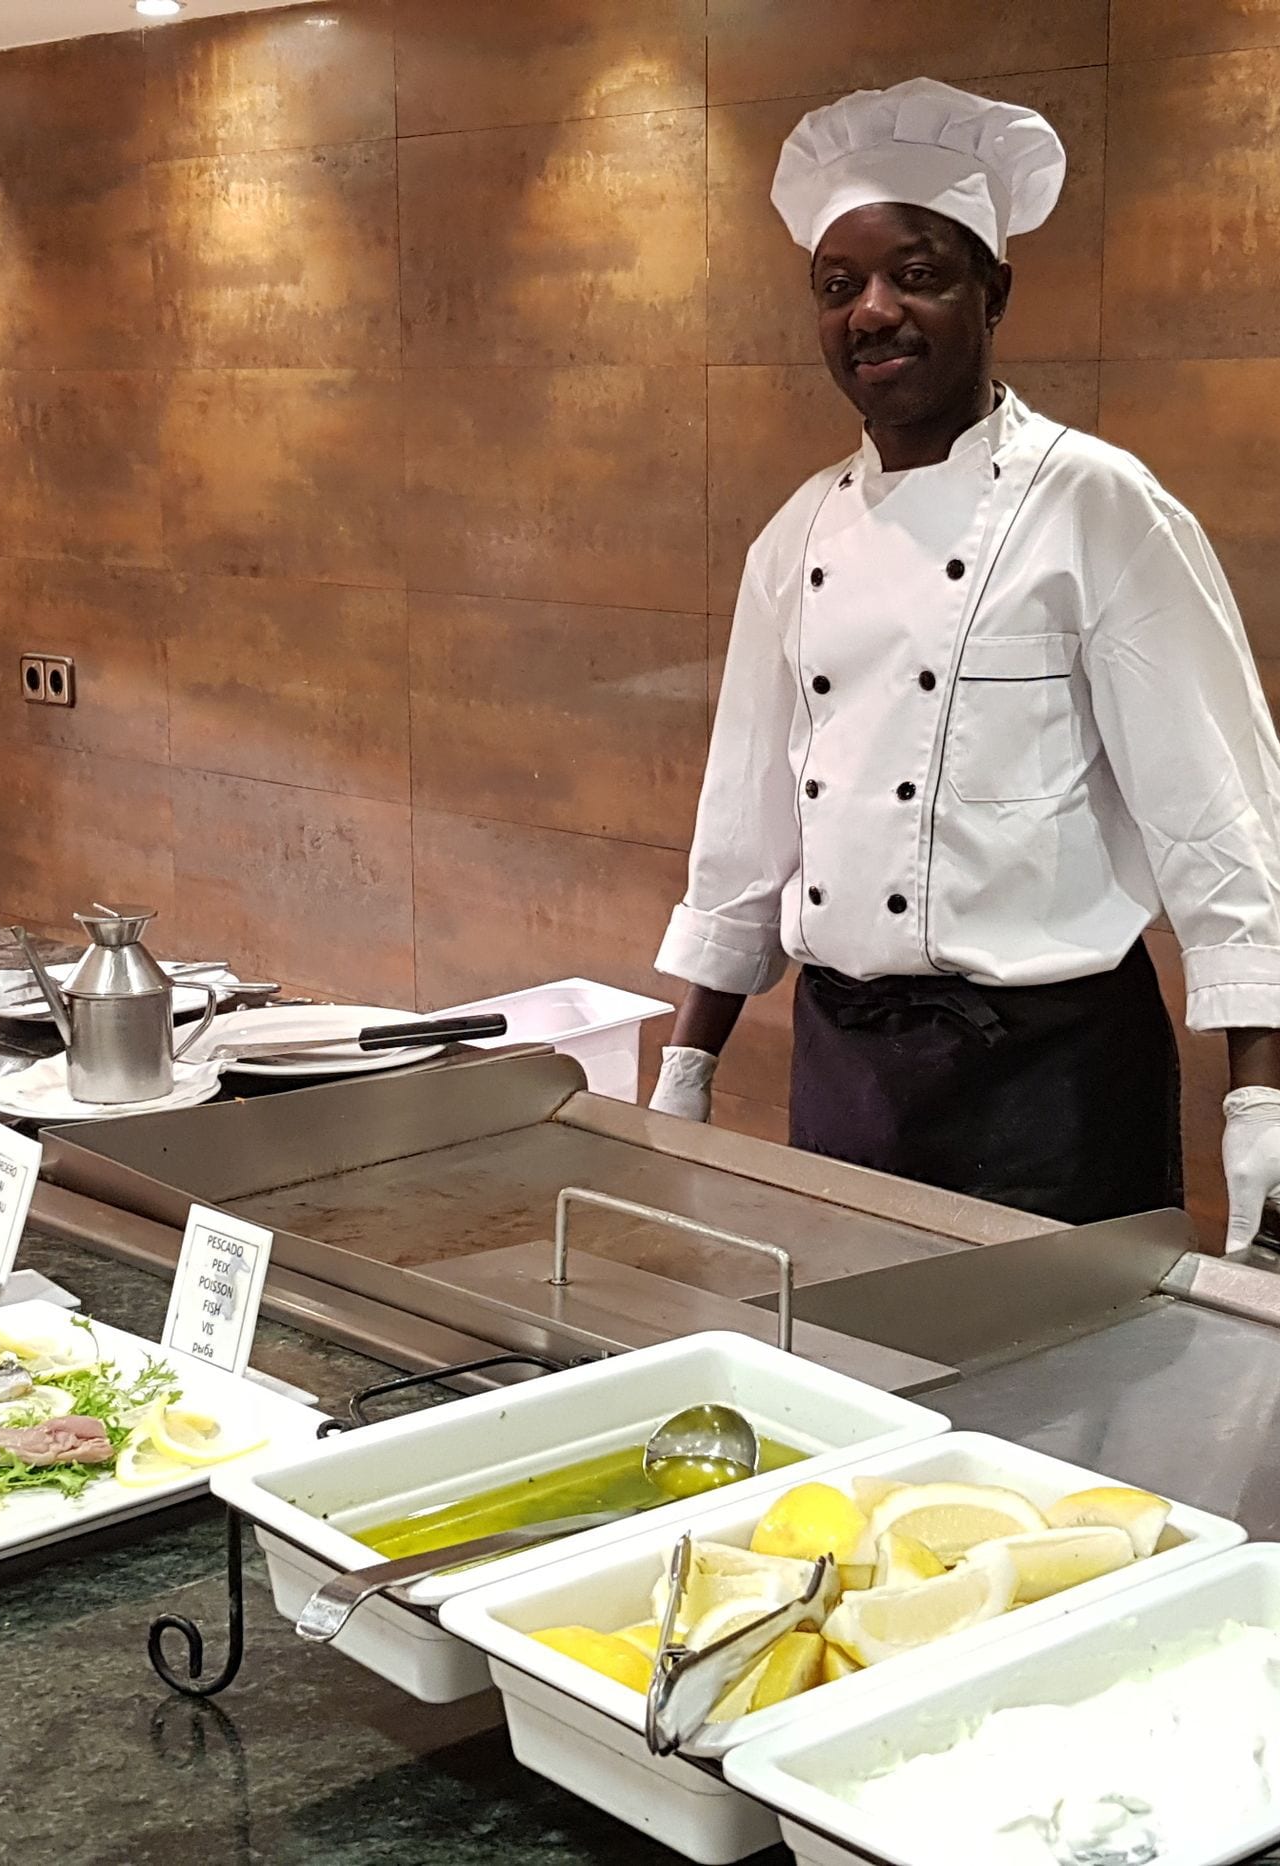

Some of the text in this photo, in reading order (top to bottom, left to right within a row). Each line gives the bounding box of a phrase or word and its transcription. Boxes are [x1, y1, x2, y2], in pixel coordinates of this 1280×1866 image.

[207, 1235, 243, 1257] PESCADO
[211, 1258, 231, 1275] PEIX
[199, 1275, 234, 1299] POISSON
[202, 1299, 222, 1316] FISH
[201, 1320, 215, 1336] VIS
[192, 1342, 214, 1358] рыба
